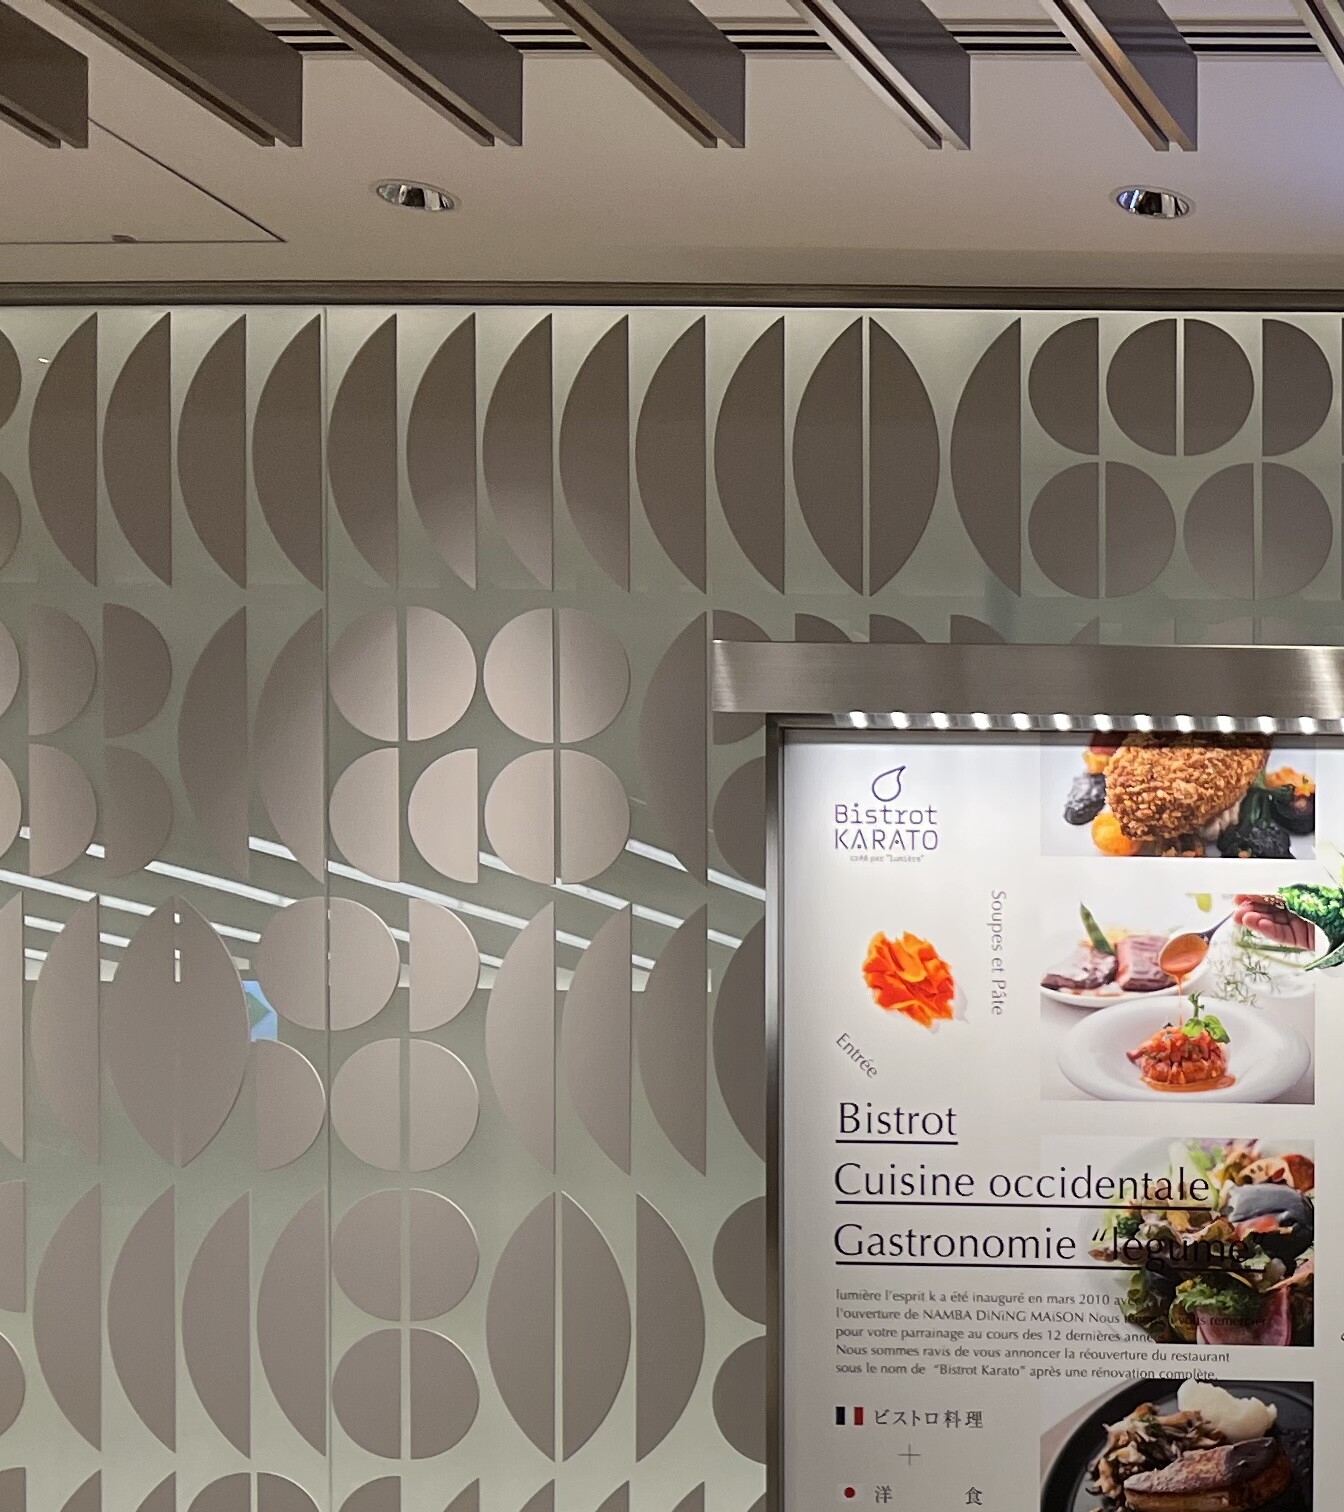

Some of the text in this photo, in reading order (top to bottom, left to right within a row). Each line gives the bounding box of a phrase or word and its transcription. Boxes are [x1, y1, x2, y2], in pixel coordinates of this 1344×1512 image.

[834, 802, 938, 825] Bistrot
[834, 828, 939, 851] KARATO
[986, 889, 1007, 1016] Soupes et Pâte
[835, 1032, 878, 1079] Entrée
[838, 1101, 958, 1139] Bistrot
[834, 1164, 1211, 1204] Cuisine occidentale
[833, 1223, 1077, 1262] Gastronomie
[835, 1288, 882, 1301] lumière
[928, 1290, 936, 1302] k
[940, 1293, 947, 1302] a
[950, 1290, 969, 1302] été
[972, 1291, 1025, 1307] inauguré
[1028, 1294, 1043, 1304] en
[1046, 1295, 1075, 1305] mars
[1078, 1294, 1110, 1305] 2010
[904, 1308, 919, 1320] de
[923, 1309, 973, 1321] NAMBA
[1088, 1312, 1120, 1324] Nous
[835, 1327, 864, 1339] pour
[867, 1328, 898, 1338] votre
[900, 1329, 965, 1342] parrainage
[968, 1329, 982, 1340] au
[986, 1330, 1019, 1340] cours
[1022, 1329, 1043, 1341] des
[1048, 1330, 1062, 1341] 12
[1065, 1330, 1121, 1342] dernières
[836, 1344, 1230, 1363] Nous sommes ravis de vous annoncer la réouverture du restaurant
[835, 1364, 862, 1374] sous
[866, 1362, 878, 1374] le
[880, 1364, 907, 1374] nom
[910, 1363, 926, 1375] de
[1029, 1366, 1062, 1379] après
[1065, 1368, 1088, 1378] une
[1091, 1367, 1155, 1379] rénovation
[874, 1408, 984, 1429] ビストロ料理
